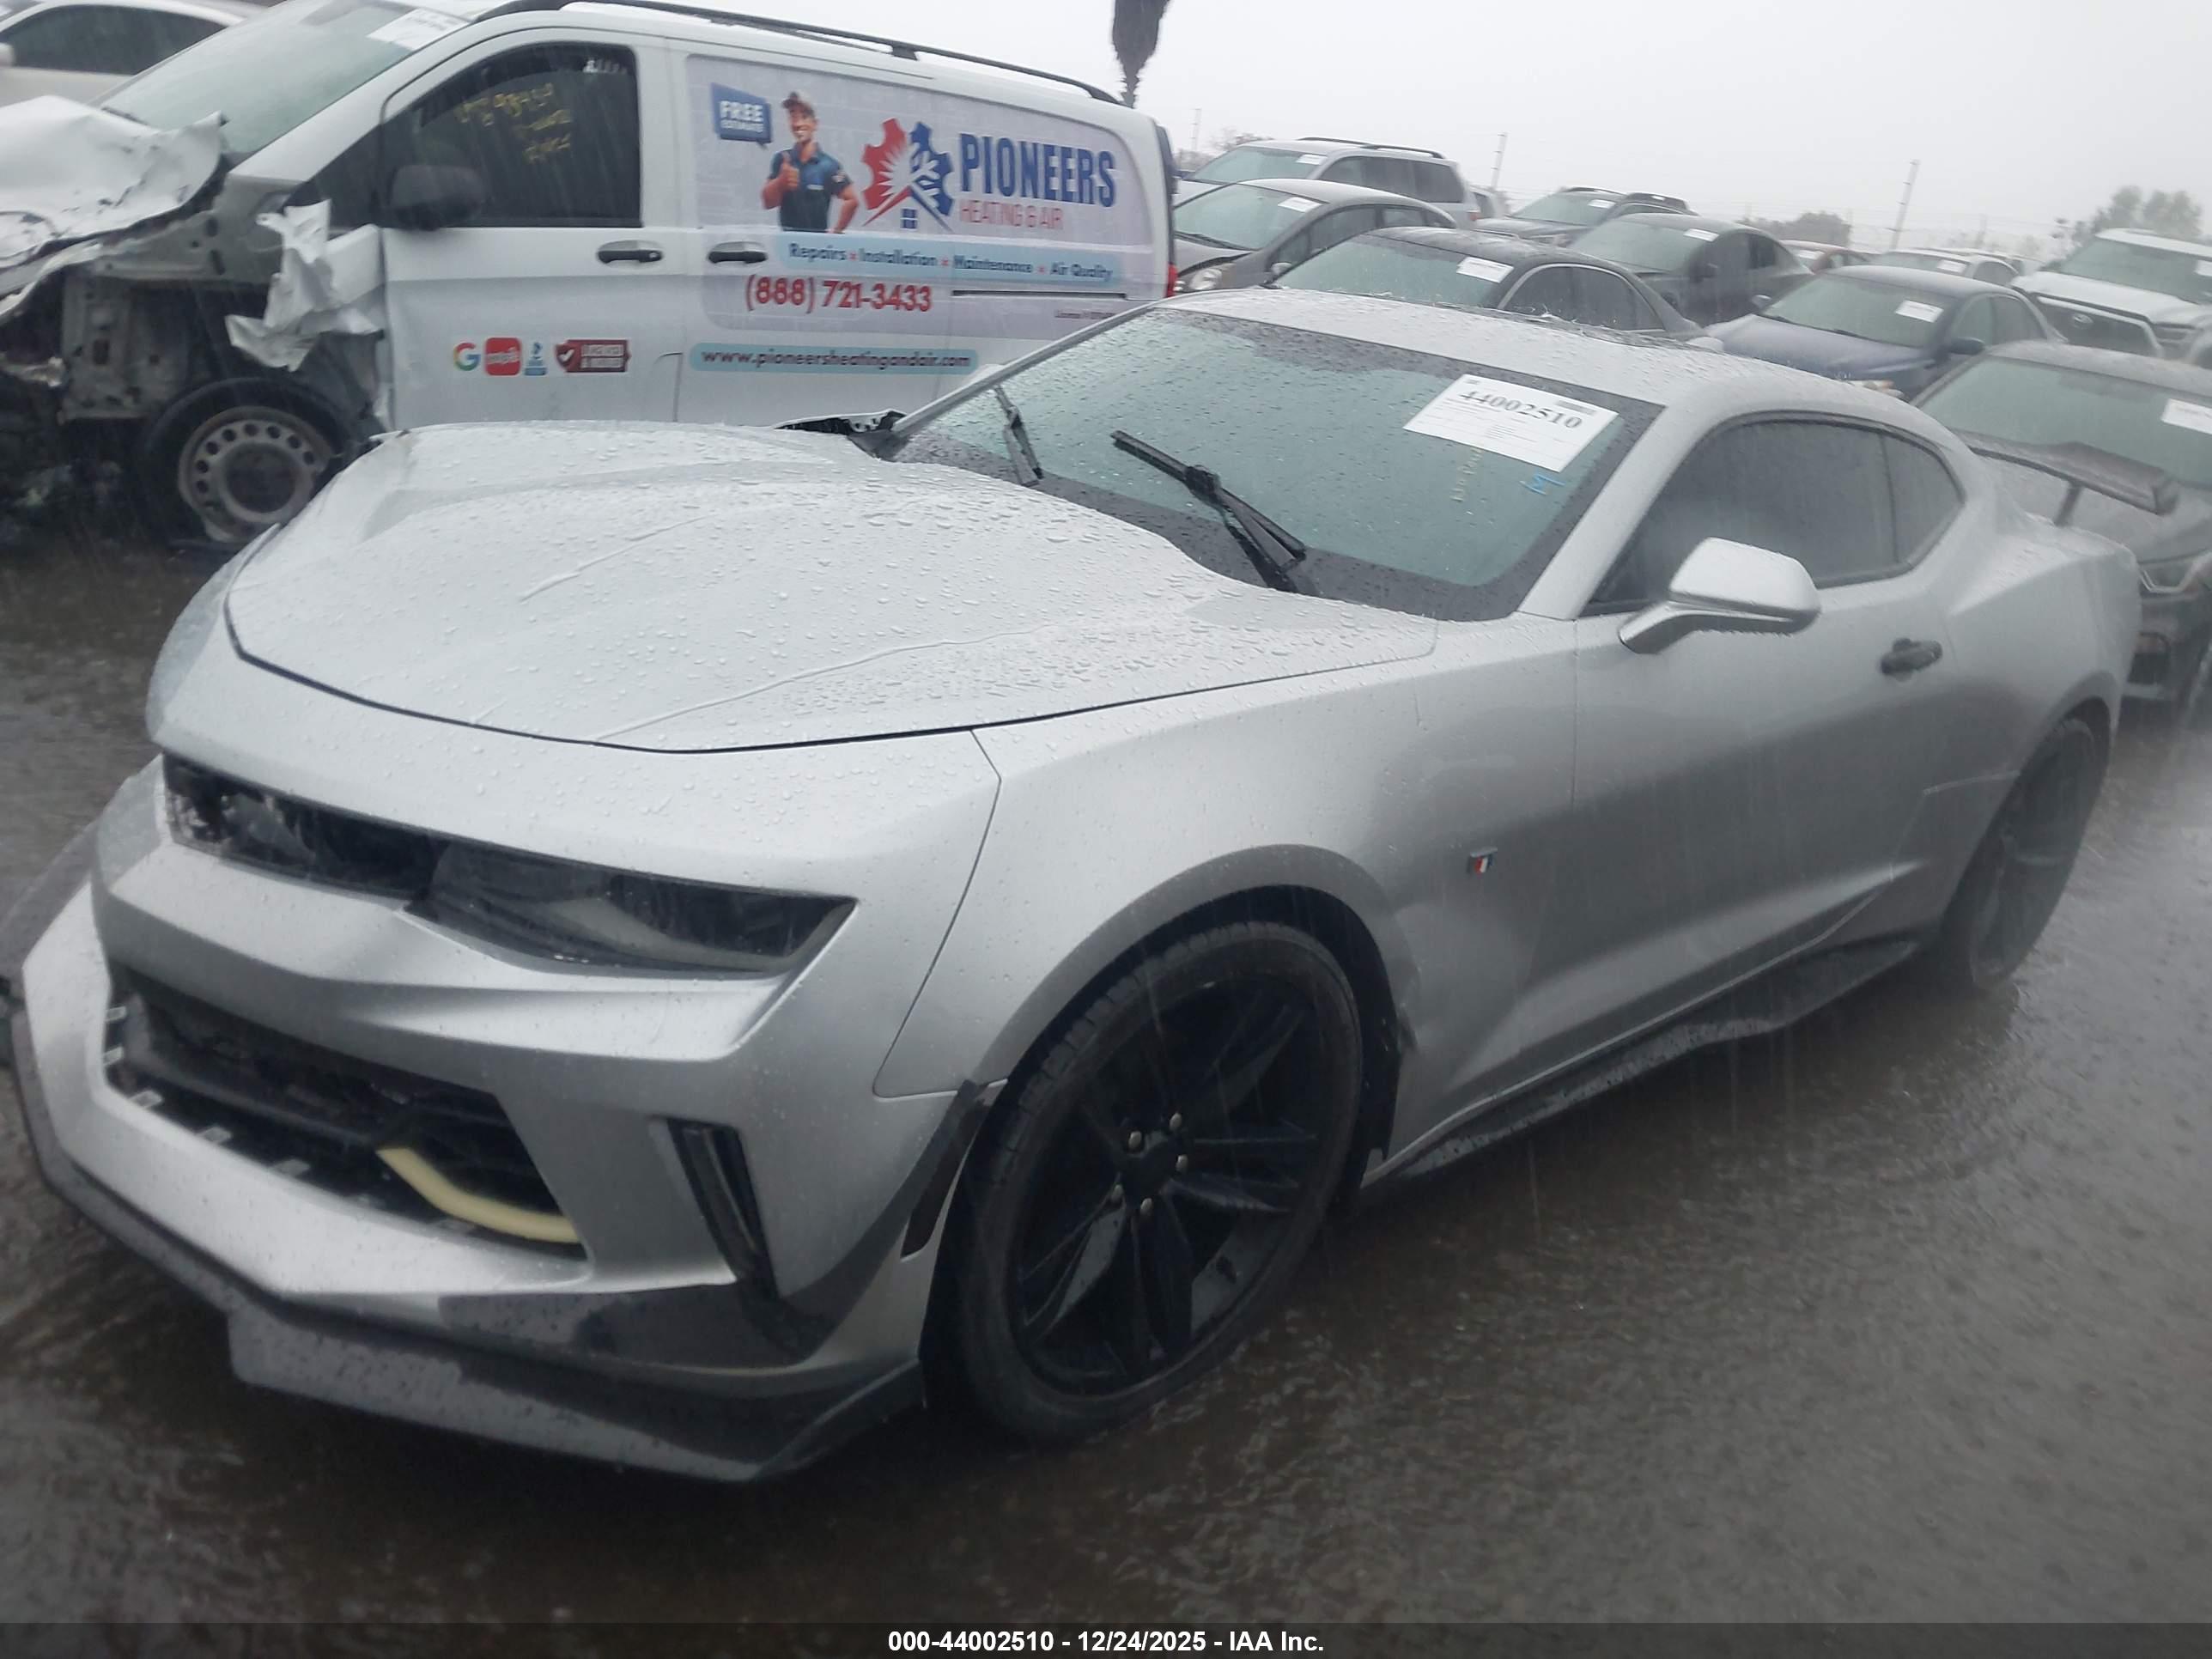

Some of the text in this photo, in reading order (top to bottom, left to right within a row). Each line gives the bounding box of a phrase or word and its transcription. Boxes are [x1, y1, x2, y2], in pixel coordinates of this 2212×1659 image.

[719, 100, 764, 122] FREE
[959, 132, 1115, 208] PIONEERS
[960, 198, 1023, 228] HEATING
[1040, 206, 1064, 230] AIR
[788, 242, 1114, 282] Repairs Installation Maintenance Air Quality
[745, 273, 932, 314] (888) 721-3433
[700, 339, 970, 370] www.pioneersheatingandair.com
[1459, 390, 1583, 429] 44002510
